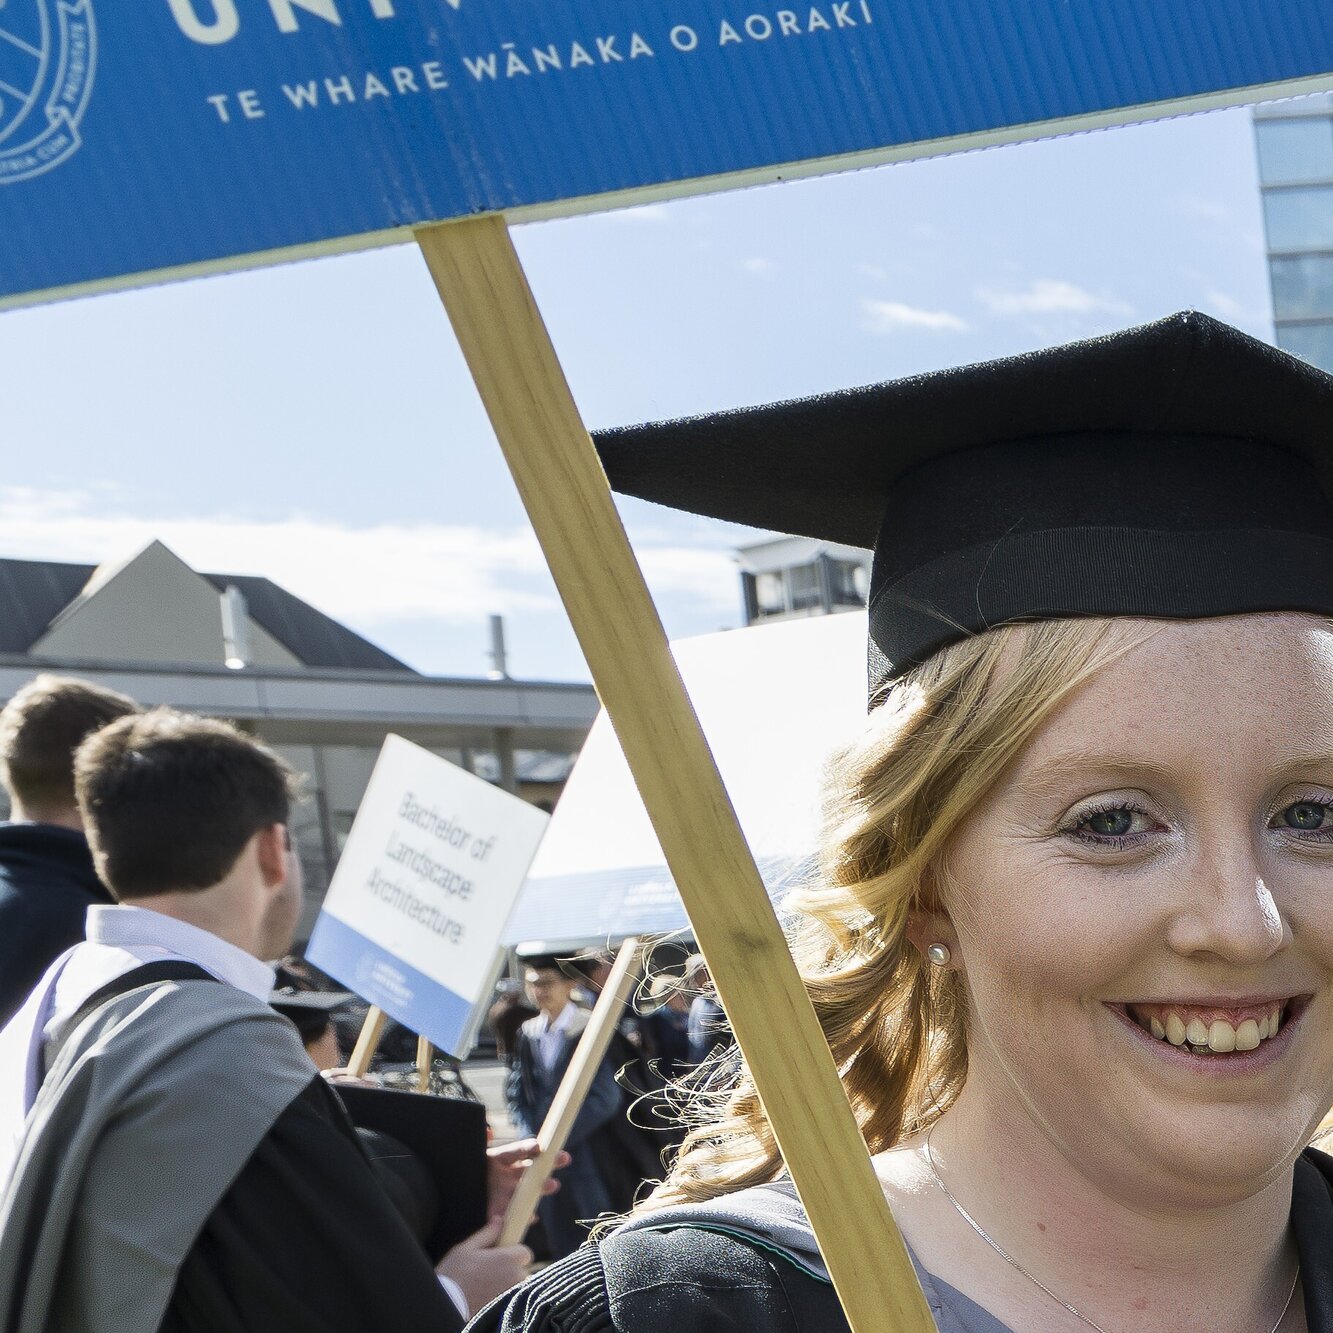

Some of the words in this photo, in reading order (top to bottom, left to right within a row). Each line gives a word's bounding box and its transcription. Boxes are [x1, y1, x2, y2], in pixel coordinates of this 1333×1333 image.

[206, 90, 265, 123] TE
[282, 61, 449, 110] WHARE
[463, 32, 655, 82] WĀNAKA
[669, 24, 699, 52] O
[718, 0, 872, 46] AORAKI
[397, 791, 468, 850] Bachelor
[469, 835, 498, 861] of
[384, 830, 474, 902] Landscape
[365, 866, 466, 945] Architecture
